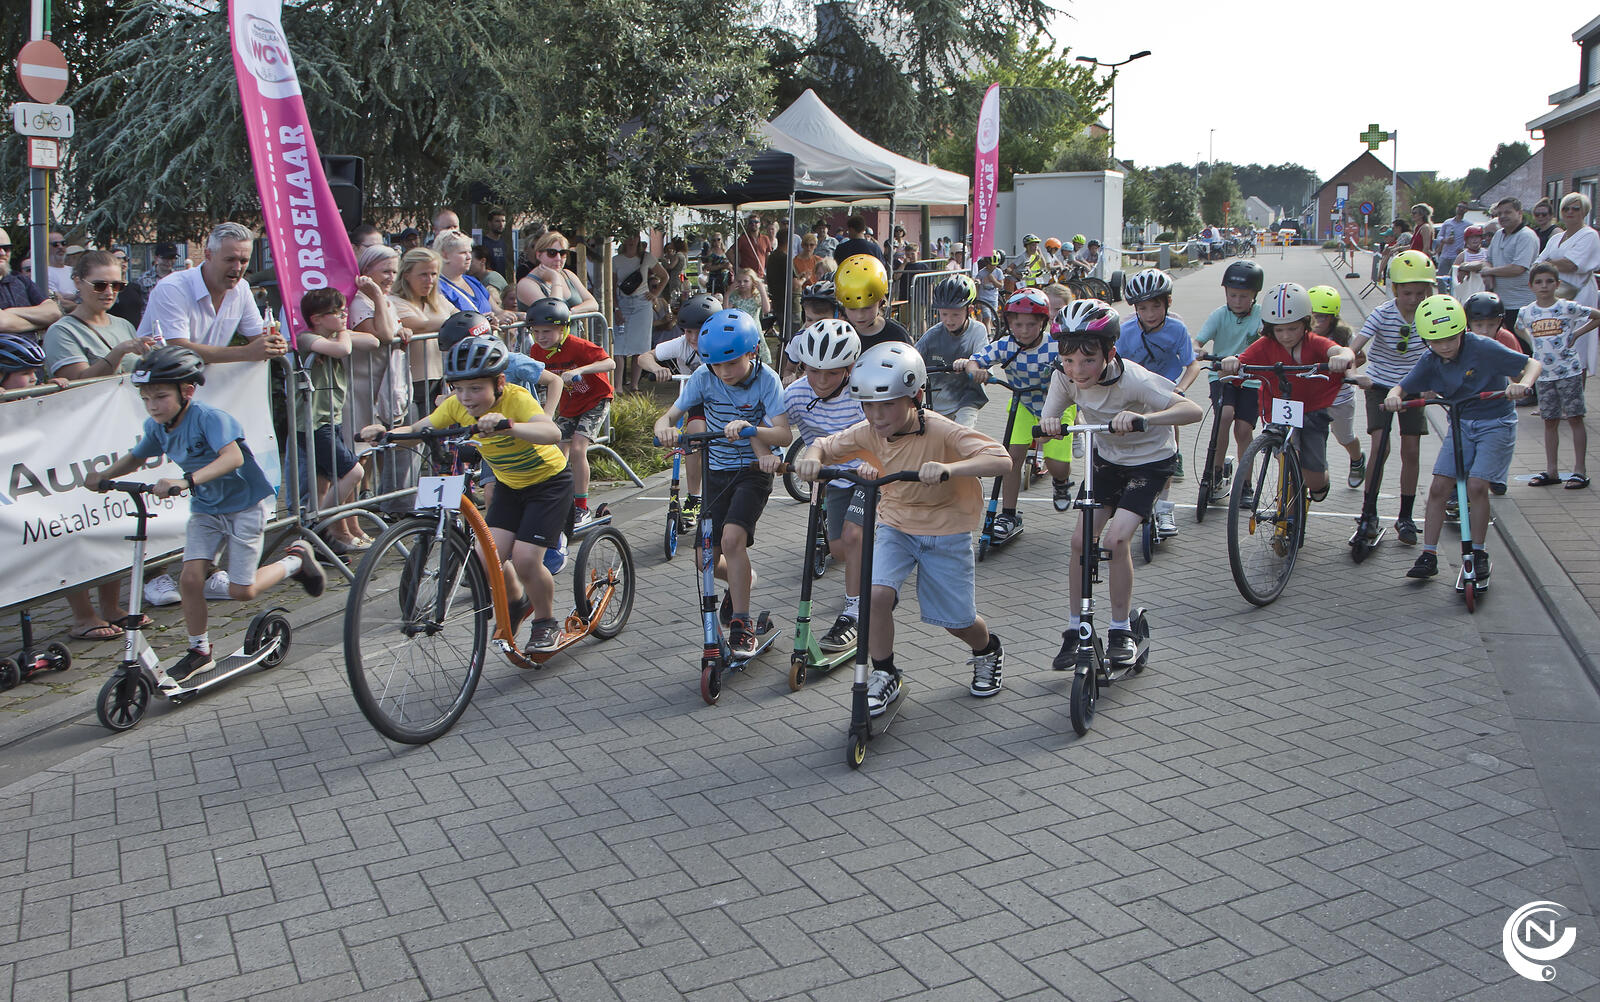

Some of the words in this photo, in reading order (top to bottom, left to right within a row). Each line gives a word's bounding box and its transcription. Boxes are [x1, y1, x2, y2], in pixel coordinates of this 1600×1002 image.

[278, 124, 328, 296] ORSELAAR
[1283, 405, 1292, 419] 3
[433, 484, 444, 502] 1
[22, 503, 100, 545] Metals
[103, 496, 129, 521] for
